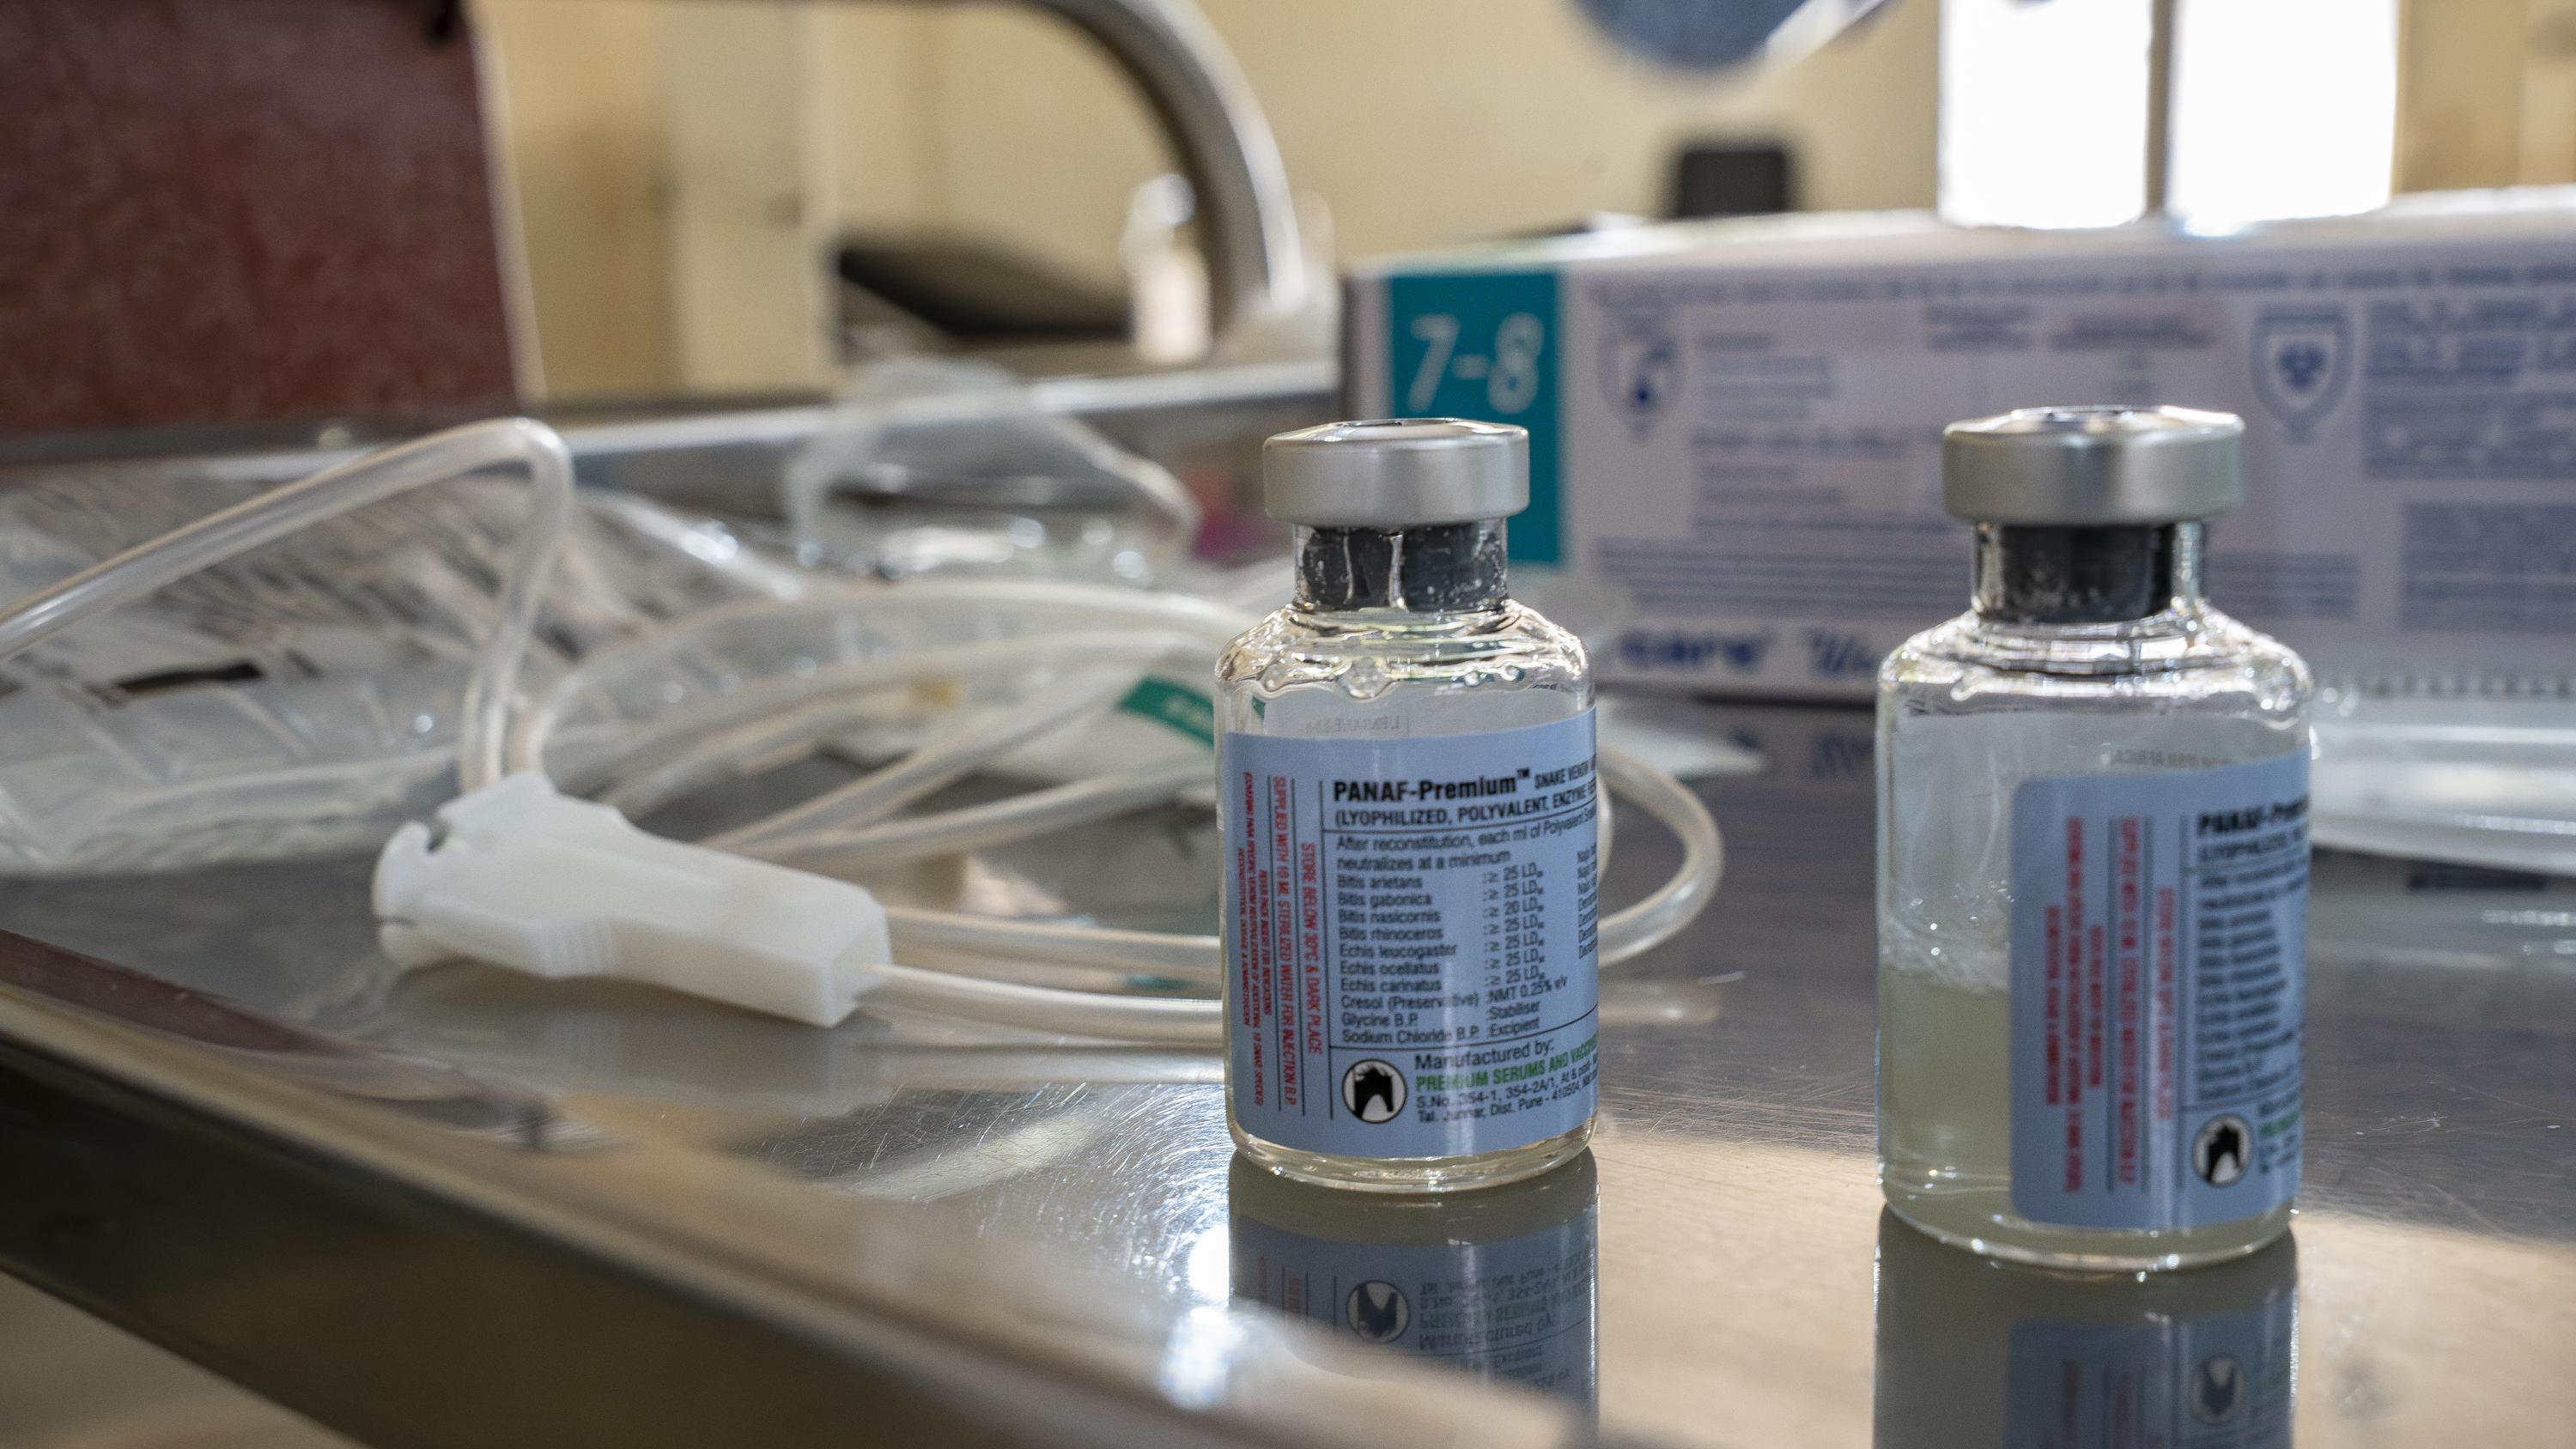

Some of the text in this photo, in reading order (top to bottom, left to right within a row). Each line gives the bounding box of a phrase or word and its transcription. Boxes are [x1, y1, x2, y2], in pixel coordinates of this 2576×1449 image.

[1407, 312, 1545, 415] 7-8
[1273, 776, 1288, 831] SUPPLIED
[1335, 809, 1453, 828] (LYOPHILIZED,
[1276, 834, 1289, 862] WITH
[1337, 836, 1368, 850] After
[1373, 834, 1474, 851] reconstitution,
[1478, 830, 1510, 846] each
[1513, 824, 1527, 840] ml
[1530, 822, 1541, 839] of
[1277, 865, 1290, 879] 10
[1301, 842, 1317, 883] STORE
[1338, 851, 1510, 871] neutralizes at a minimum
[1337, 874, 1364, 888] Bitis
[1370, 876, 1422, 889] arietans
[1504, 865, 1519, 881] 25
[1338, 891, 1365, 906] Bitis
[1370, 894, 1432, 908] gabonica
[1504, 882, 1519, 898] 25
[1303, 887, 1319, 930] BELOW
[1339, 908, 1365, 923] Bitis
[1370, 910, 1441, 924] nasicornis
[1505, 900, 1520, 915] 20
[1277, 900, 1292, 961] STERILIZED
[1340, 925, 1366, 941] Bitis
[1371, 928, 1443, 941] rhinoceros
[1505, 917, 1520, 932] 25
[1340, 943, 1374, 958] Echis
[1379, 944, 1457, 961] leucogaster
[1506, 934, 1521, 949] 25
[1305, 965, 1320, 974] &
[1340, 961, 1375, 975] Echis
[1380, 961, 1439, 975] ocellatus
[1506, 951, 1521, 967] 25
[1280, 964, 1294, 1001] WATER
[1341, 978, 1376, 992] Echis
[1381, 979, 1443, 992] carinatus
[1506, 968, 1521, 984] 25
[1305, 978, 1321, 1011] DARK
[1341, 995, 1382, 1009] Cresol
[1281, 1003, 1295, 1026] FOR
[1342, 1012, 1389, 1028] Glycine
[1306, 1014, 1322, 1055] PLACE
[1343, 1029, 1392, 1043] Sodium
[1282, 1029, 1297, 1084] INJECTION
[1416, 1040, 1554, 1070] Manufactured by:
[1493, 1059, 1545, 1084] SERUMS
[1549, 1052, 1569, 1072] AND
[1518, 1096, 1543, 1112] Pune
